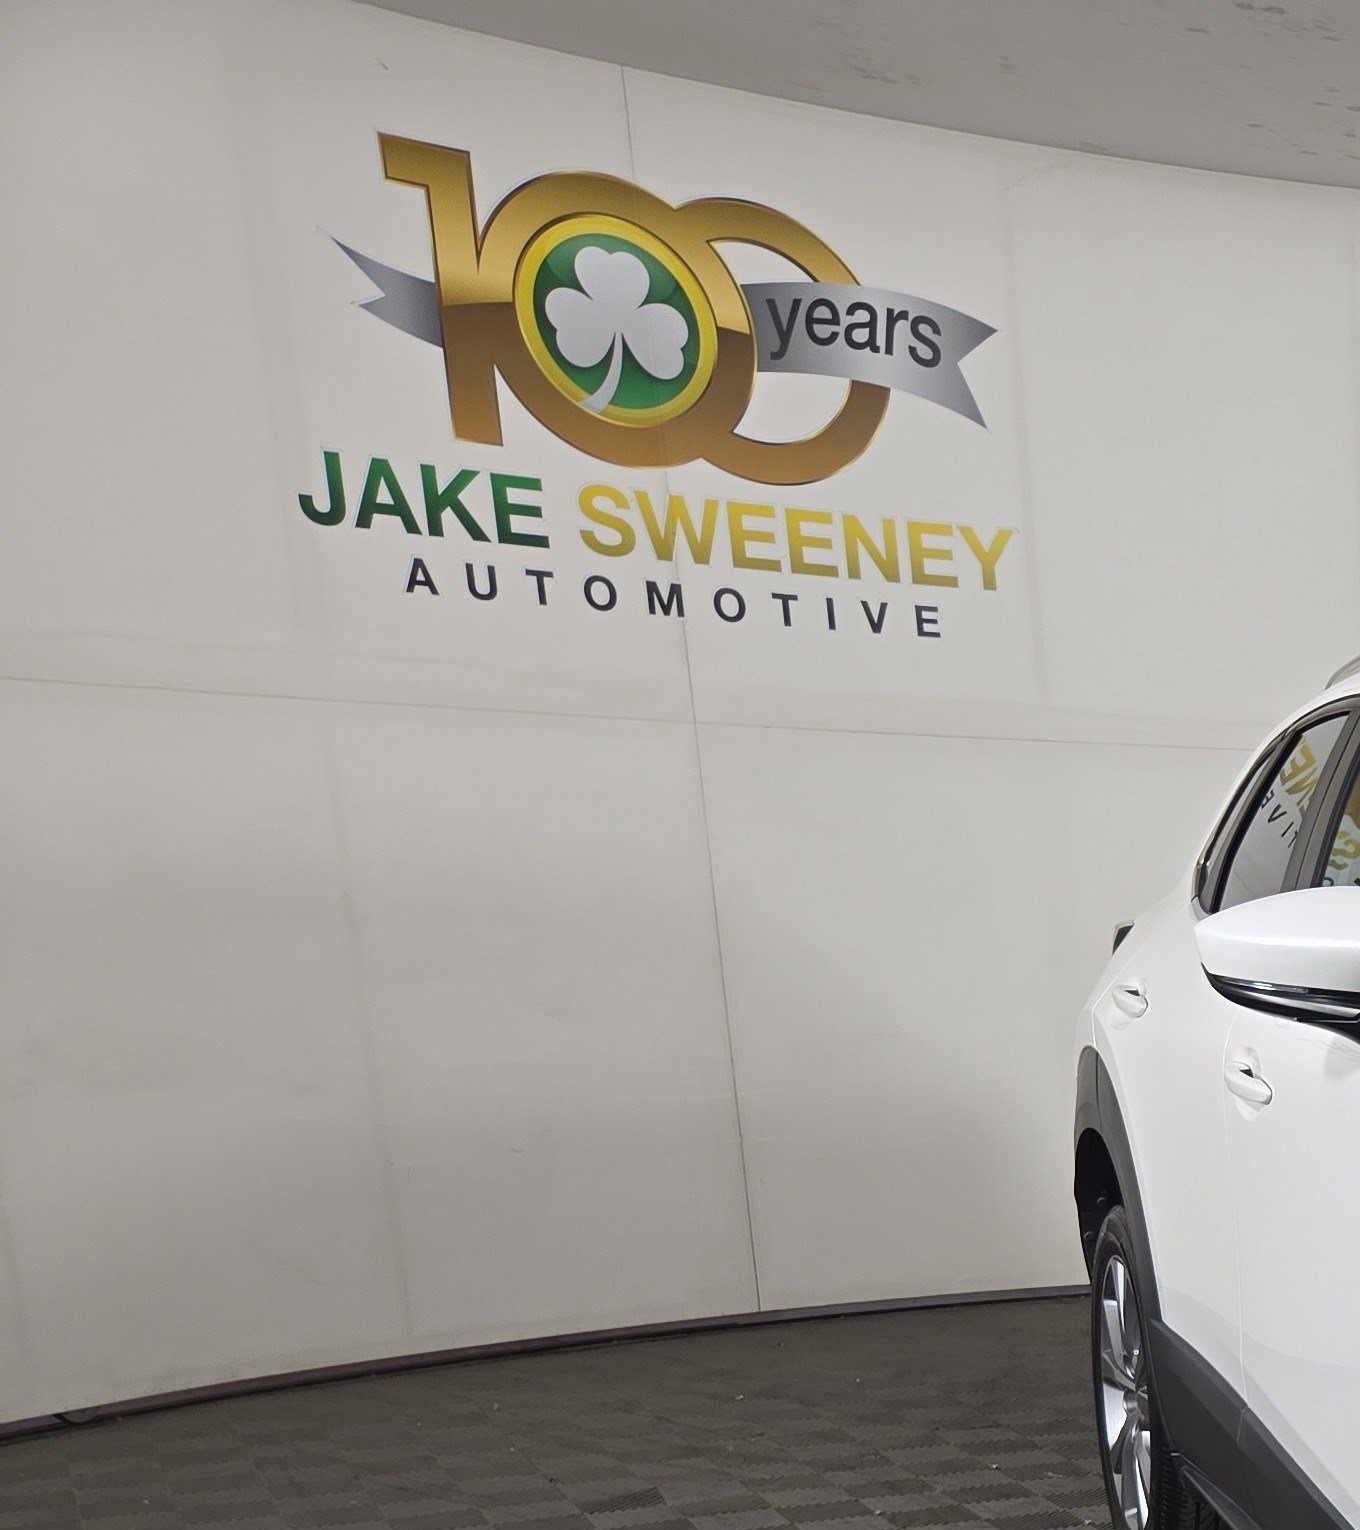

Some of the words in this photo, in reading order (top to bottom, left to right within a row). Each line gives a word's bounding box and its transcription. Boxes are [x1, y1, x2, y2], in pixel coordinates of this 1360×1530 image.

[376, 131, 891, 485] 100
[766, 294, 943, 369] years
[298, 450, 551, 549] JAKE
[578, 484, 1014, 591] SWEENEY
[405, 557, 942, 639] AUTOMOTIVE
